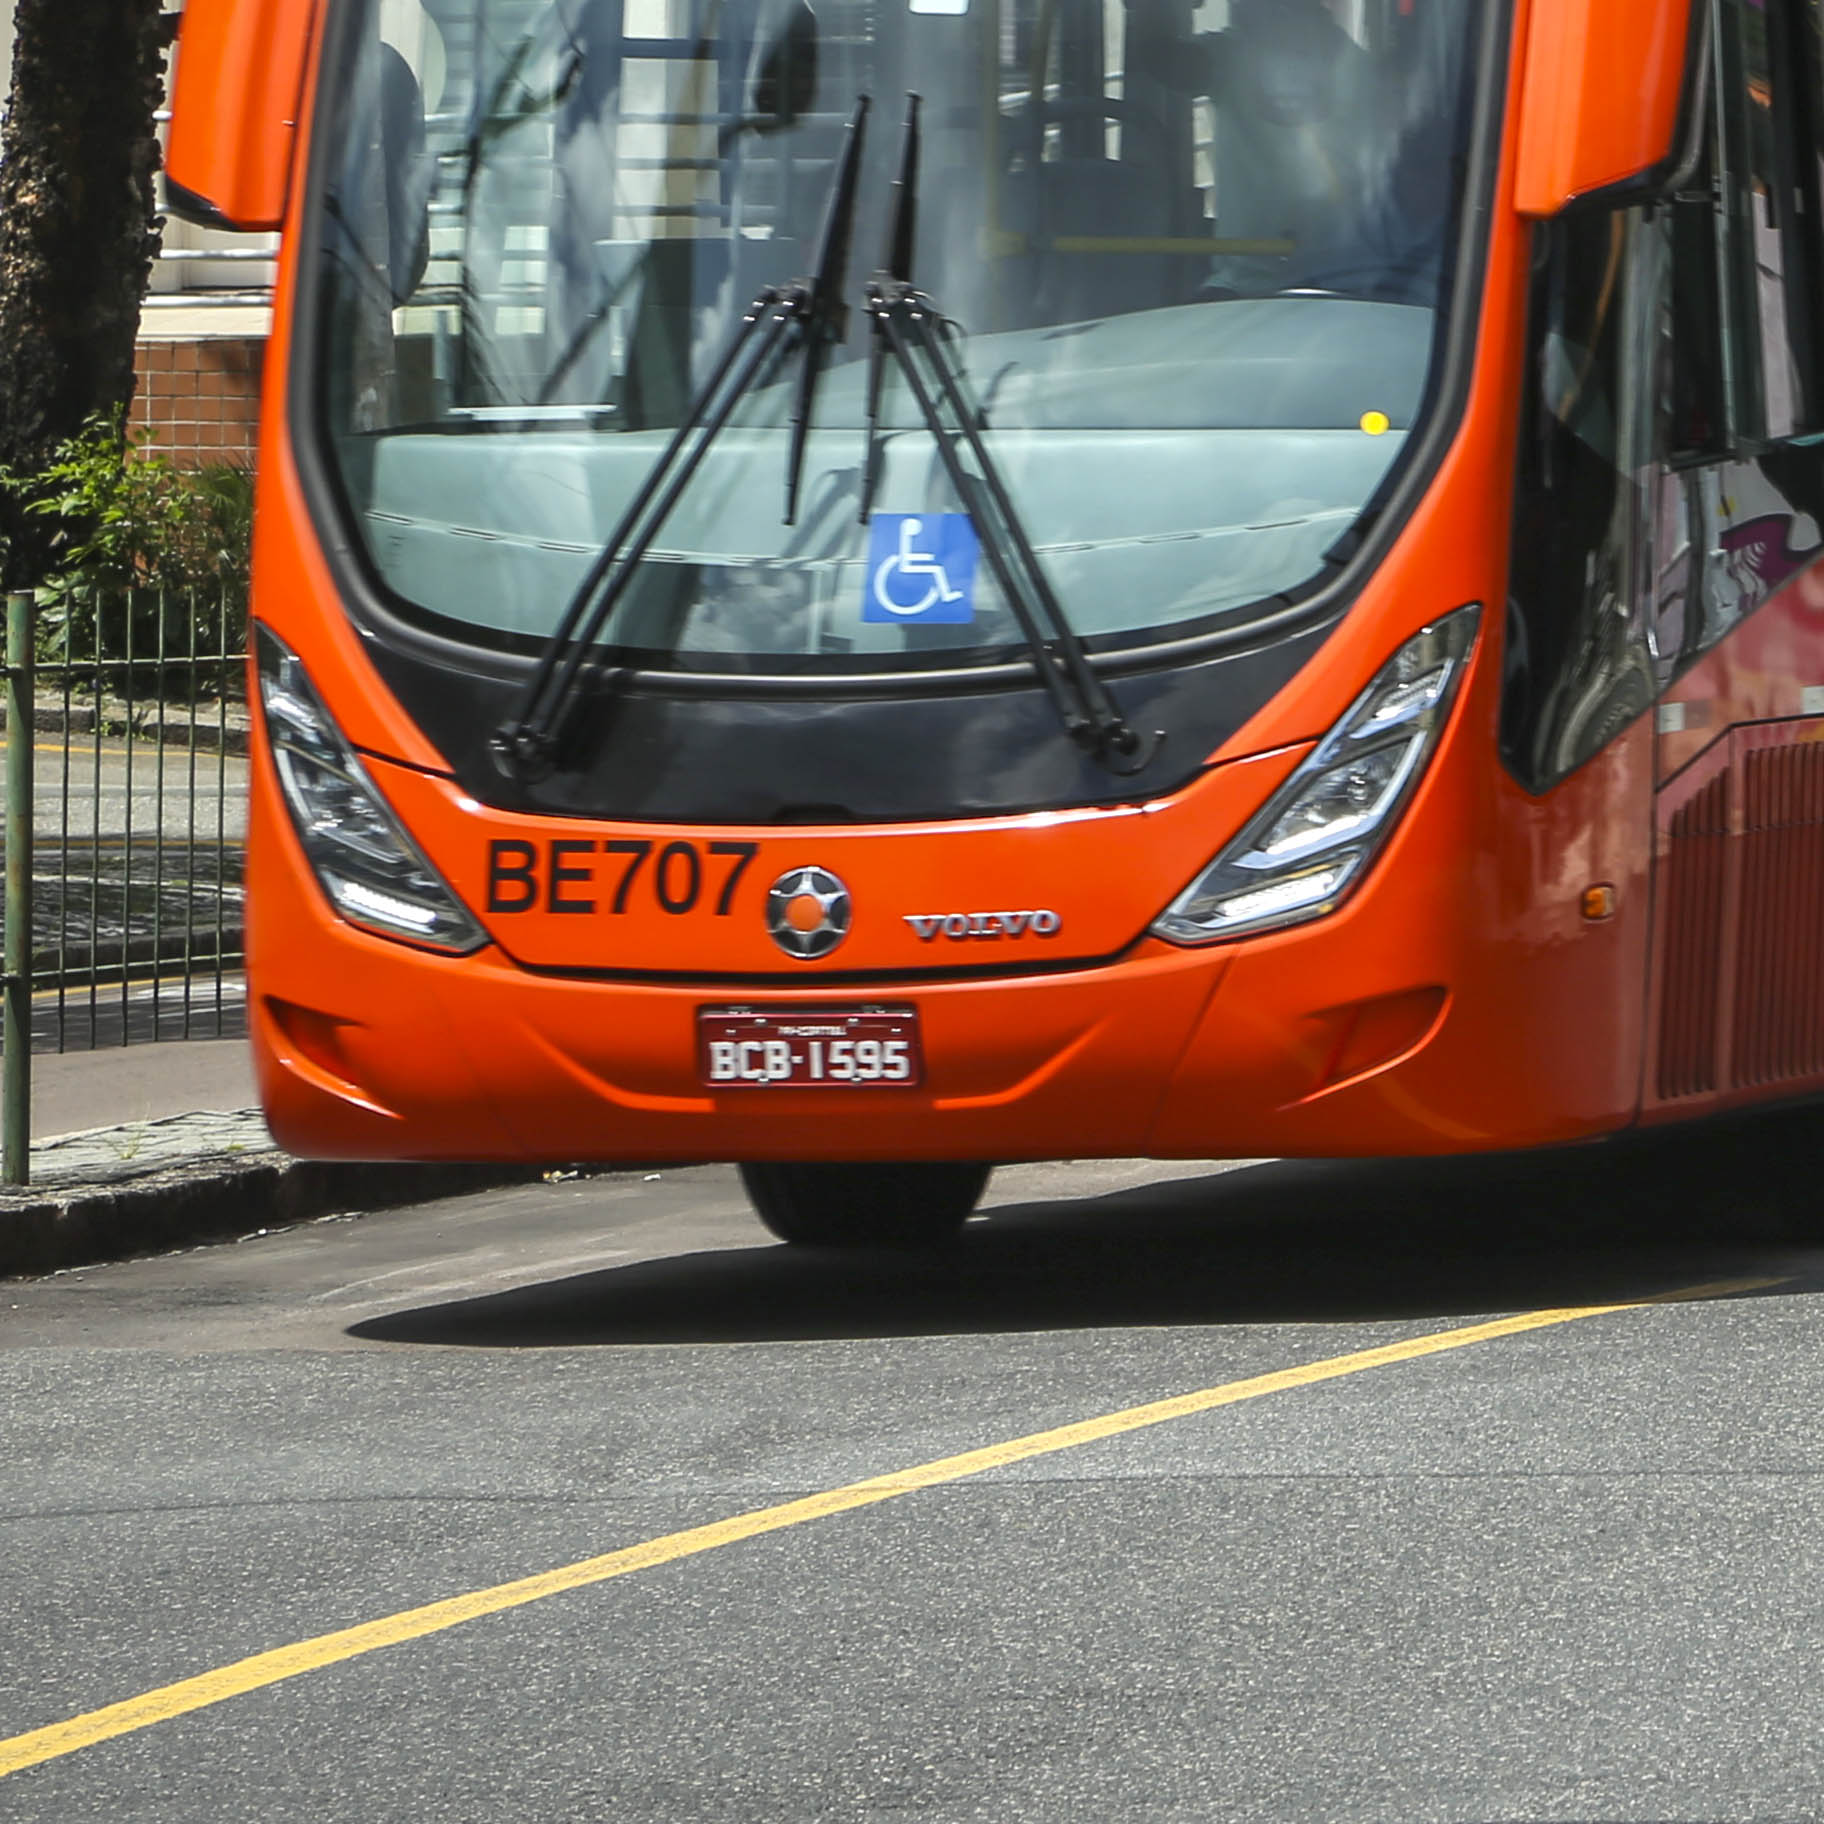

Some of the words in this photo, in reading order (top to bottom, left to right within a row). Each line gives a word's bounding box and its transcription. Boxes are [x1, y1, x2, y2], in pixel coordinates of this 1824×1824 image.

[486, 839, 760, 916] BE707
[902, 909, 1062, 939] VOLVO
[709, 1040, 910, 1080] BCB-1595
